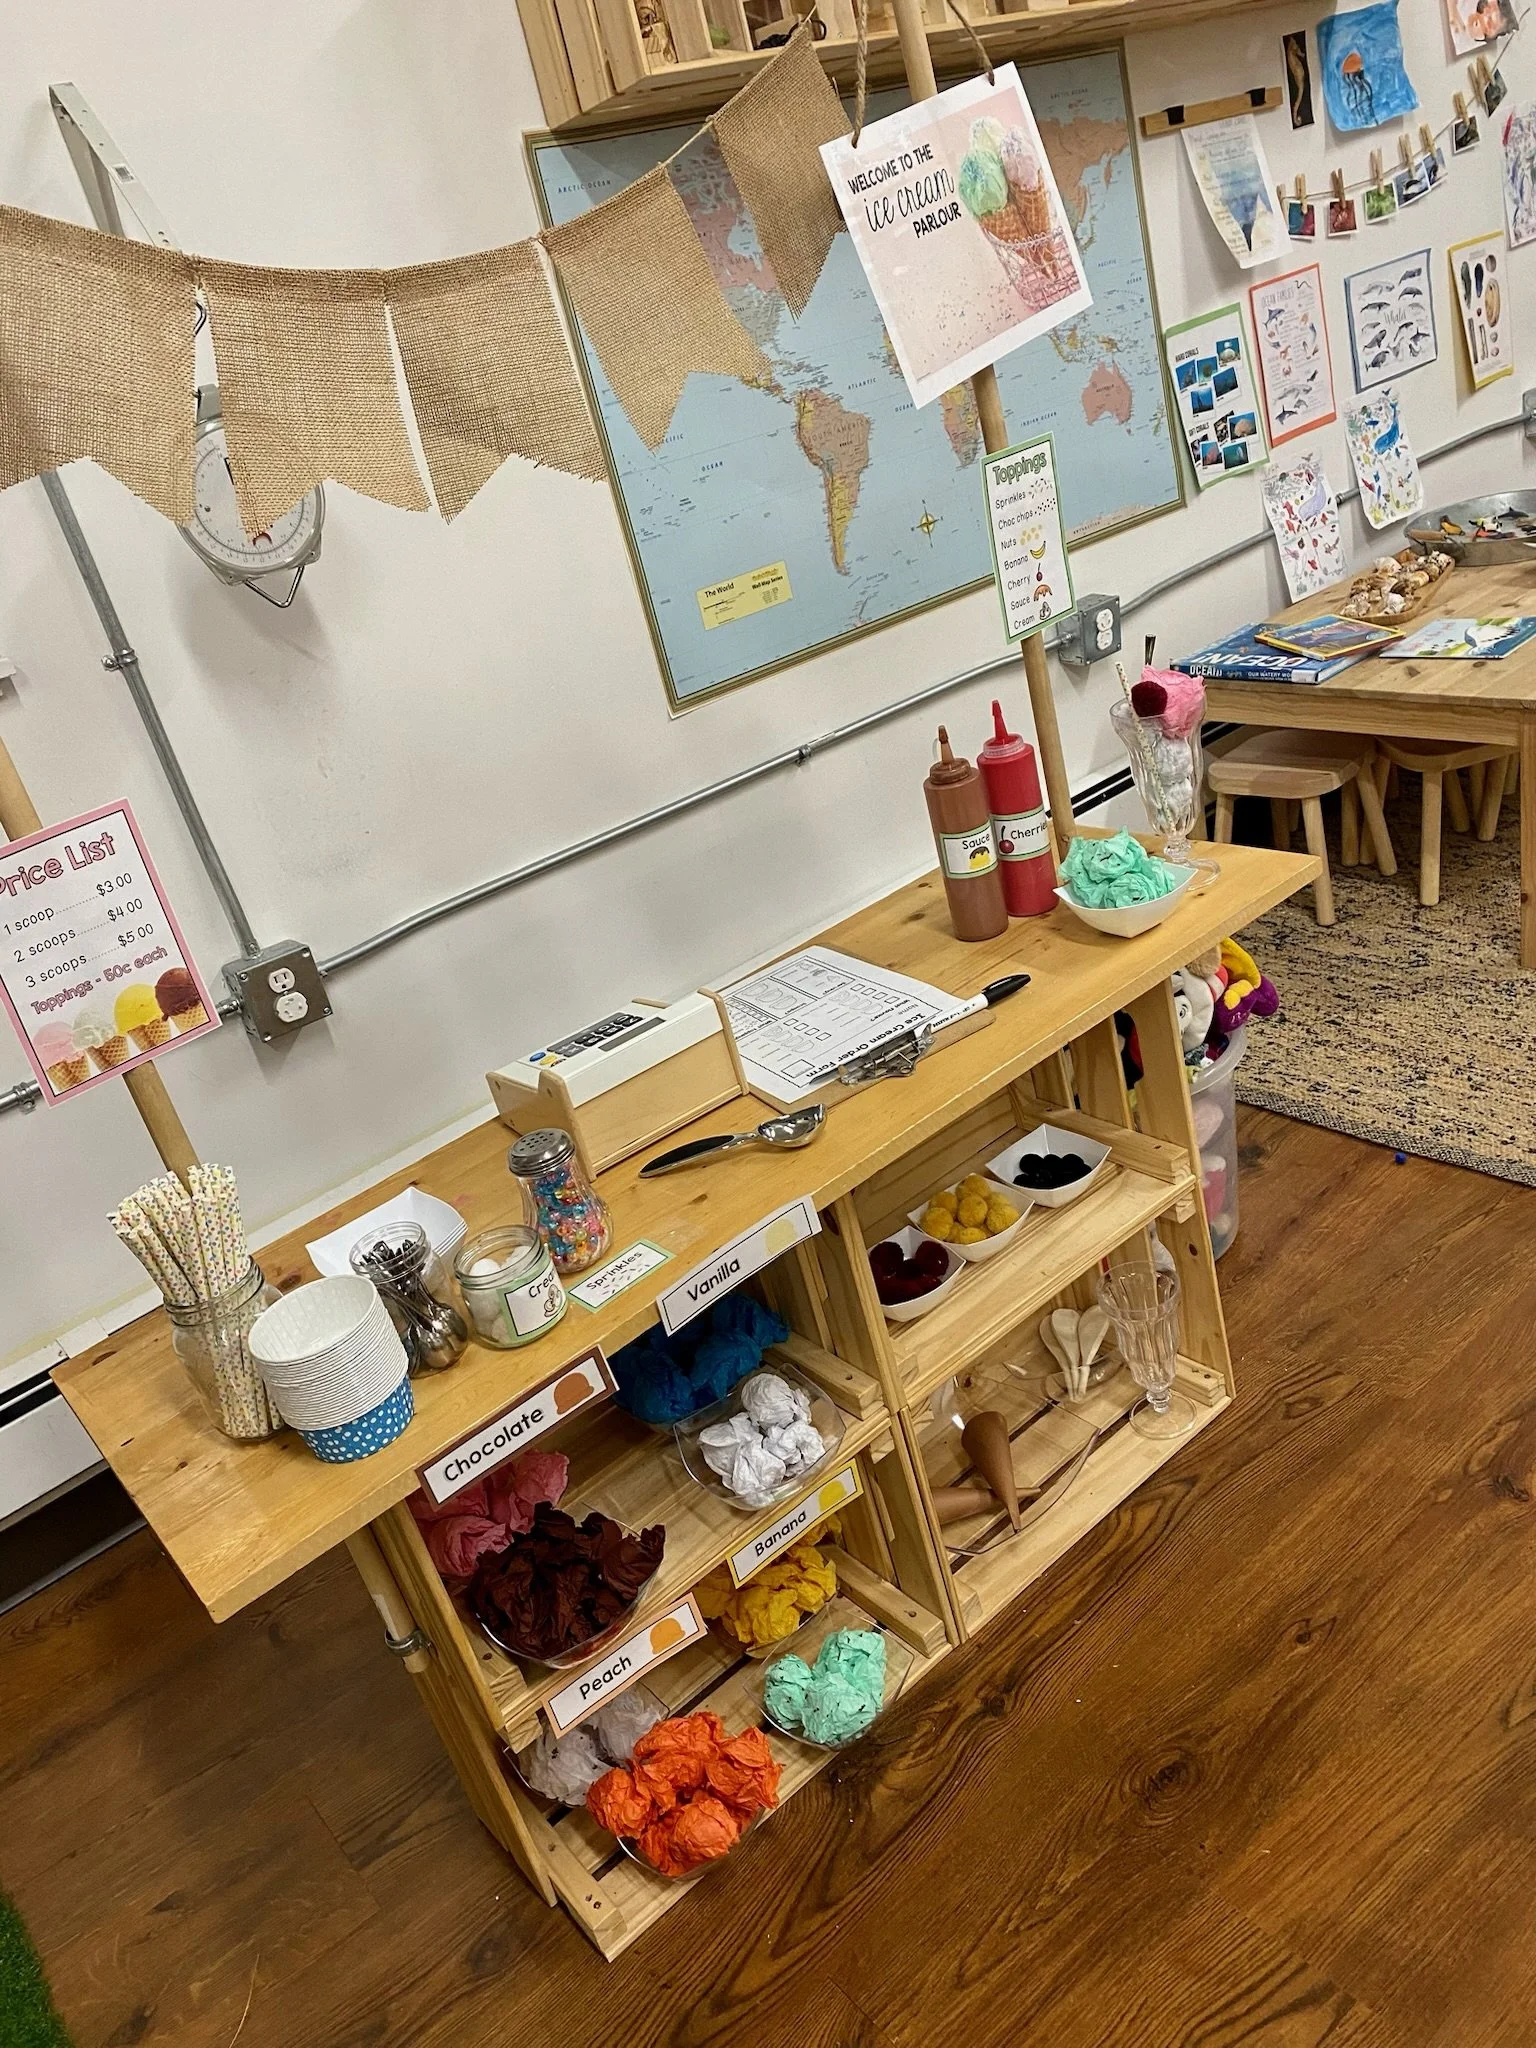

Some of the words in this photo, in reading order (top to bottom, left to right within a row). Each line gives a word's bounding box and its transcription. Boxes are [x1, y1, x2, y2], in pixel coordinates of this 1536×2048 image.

[848, 160, 899, 195] WELCOME
[898, 154, 913, 172] TO
[913, 144, 934, 164] THE
[864, 196, 895, 232] ice
[897, 168, 954, 218] cream
[913, 202, 962, 238] PARLOUR
[848, 377, 877, 390] ATLANTIC
[992, 451, 1048, 486] Toppings
[995, 491, 1026, 510] Sprinkles
[998, 516, 1016, 530] Choc
[1016, 510, 1034, 524] chips
[1000, 537, 1017, 550] Nuts
[1004, 554, 1029, 570] Banana
[704, 590, 716, 598] The
[717, 582, 735, 594] World
[1007, 573, 1031, 590] Cherry
[1010, 595, 1031, 611] Sauce
[1013, 614, 1036, 630] Cream
[65, 832, 118, 871] List
[962, 833, 990, 850] Sauce
[4, 923, 12, 936] 1
[15, 907, 55, 932] scoop
[96, 872, 132, 897] $3.00
[13, 950, 25, 964] 2
[28, 927, 76, 957] scoops
[107, 898, 144, 923] $4.00
[25, 975, 36, 988] 3
[40, 953, 88, 982] scoops
[117, 923, 154, 948] $5.00
[30, 976, 94, 1016] Toppings
[103, 961, 132, 984] 50c
[134, 945, 168, 970] each
[905, 1013, 926, 1024] Ice
[870, 1024, 905, 1044] Cream
[838, 1044, 869, 1062] Order
[806, 1062, 837, 1078] Form
[586, 1251, 644, 1290] Sprinkles
[687, 1257, 741, 1303] Vanilla
[528, 1272, 554, 1298] Crea
[444, 1408, 544, 1481] Chocolate
[754, 1510, 807, 1557] Banana
[578, 1654, 632, 1700] Peach
